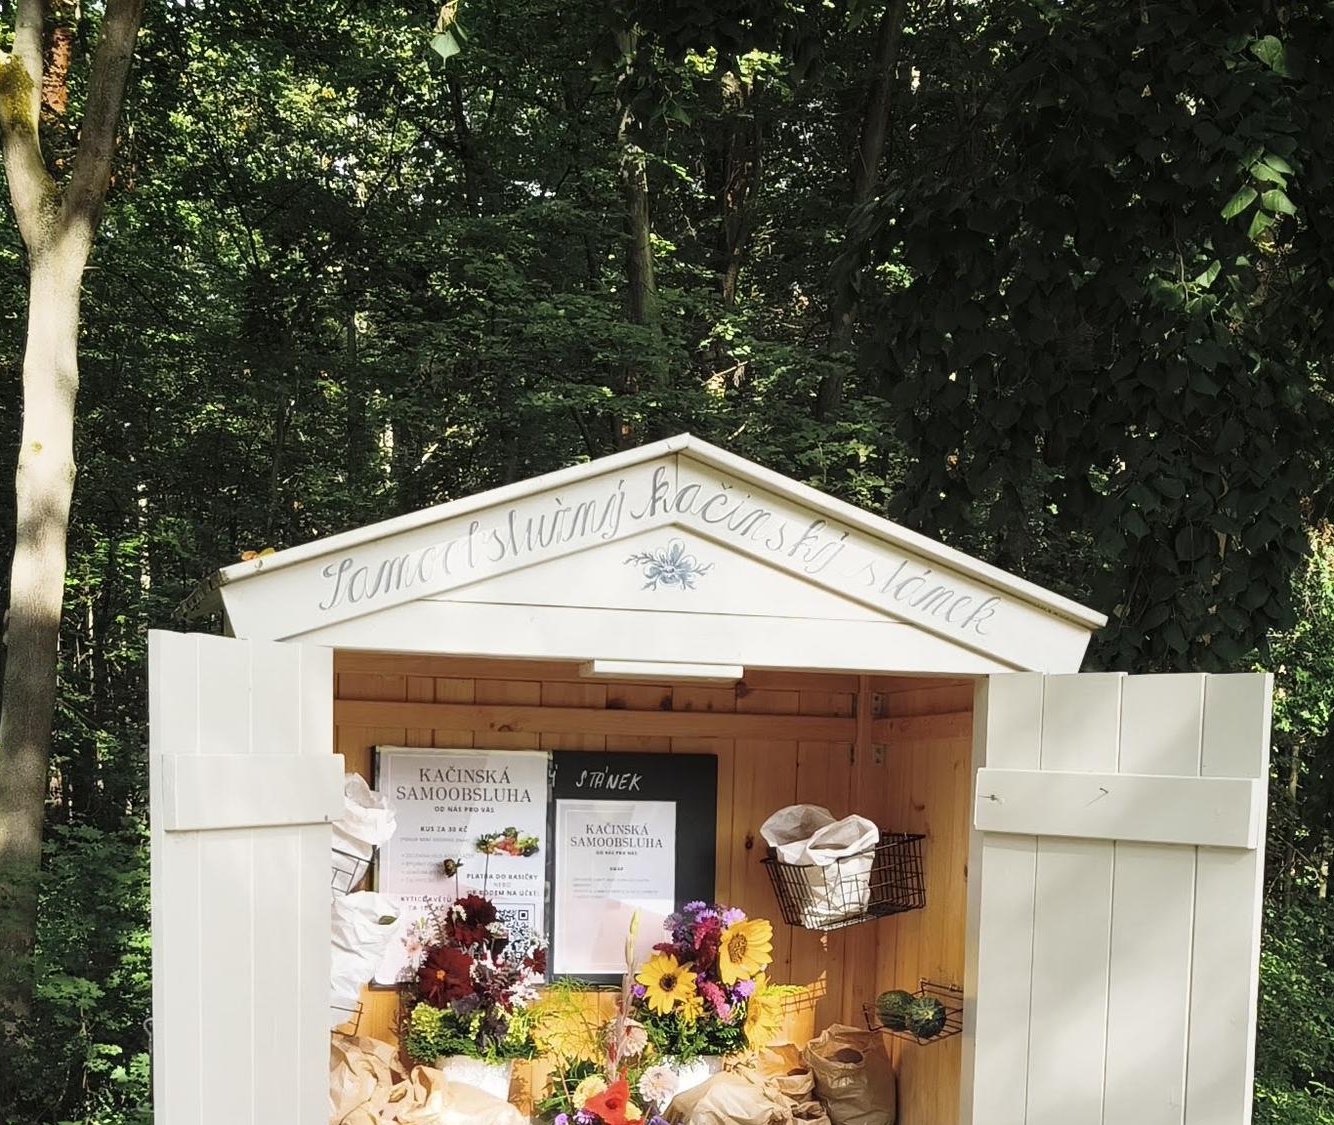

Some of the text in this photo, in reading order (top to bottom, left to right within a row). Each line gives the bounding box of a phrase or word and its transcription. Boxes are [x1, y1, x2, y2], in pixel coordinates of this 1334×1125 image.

[419, 765, 511, 784] KAČINSKÁ
[575, 765, 643, 791] STÁNEK
[396, 786, 532, 803] SAMOOBSLUHA
[447, 805, 462, 813] NÁS
[481, 805, 495, 814] VÁS
[586, 822, 649, 836] KAČINSKÁ
[570, 836, 663, 848] SAMOOBSLUHA
